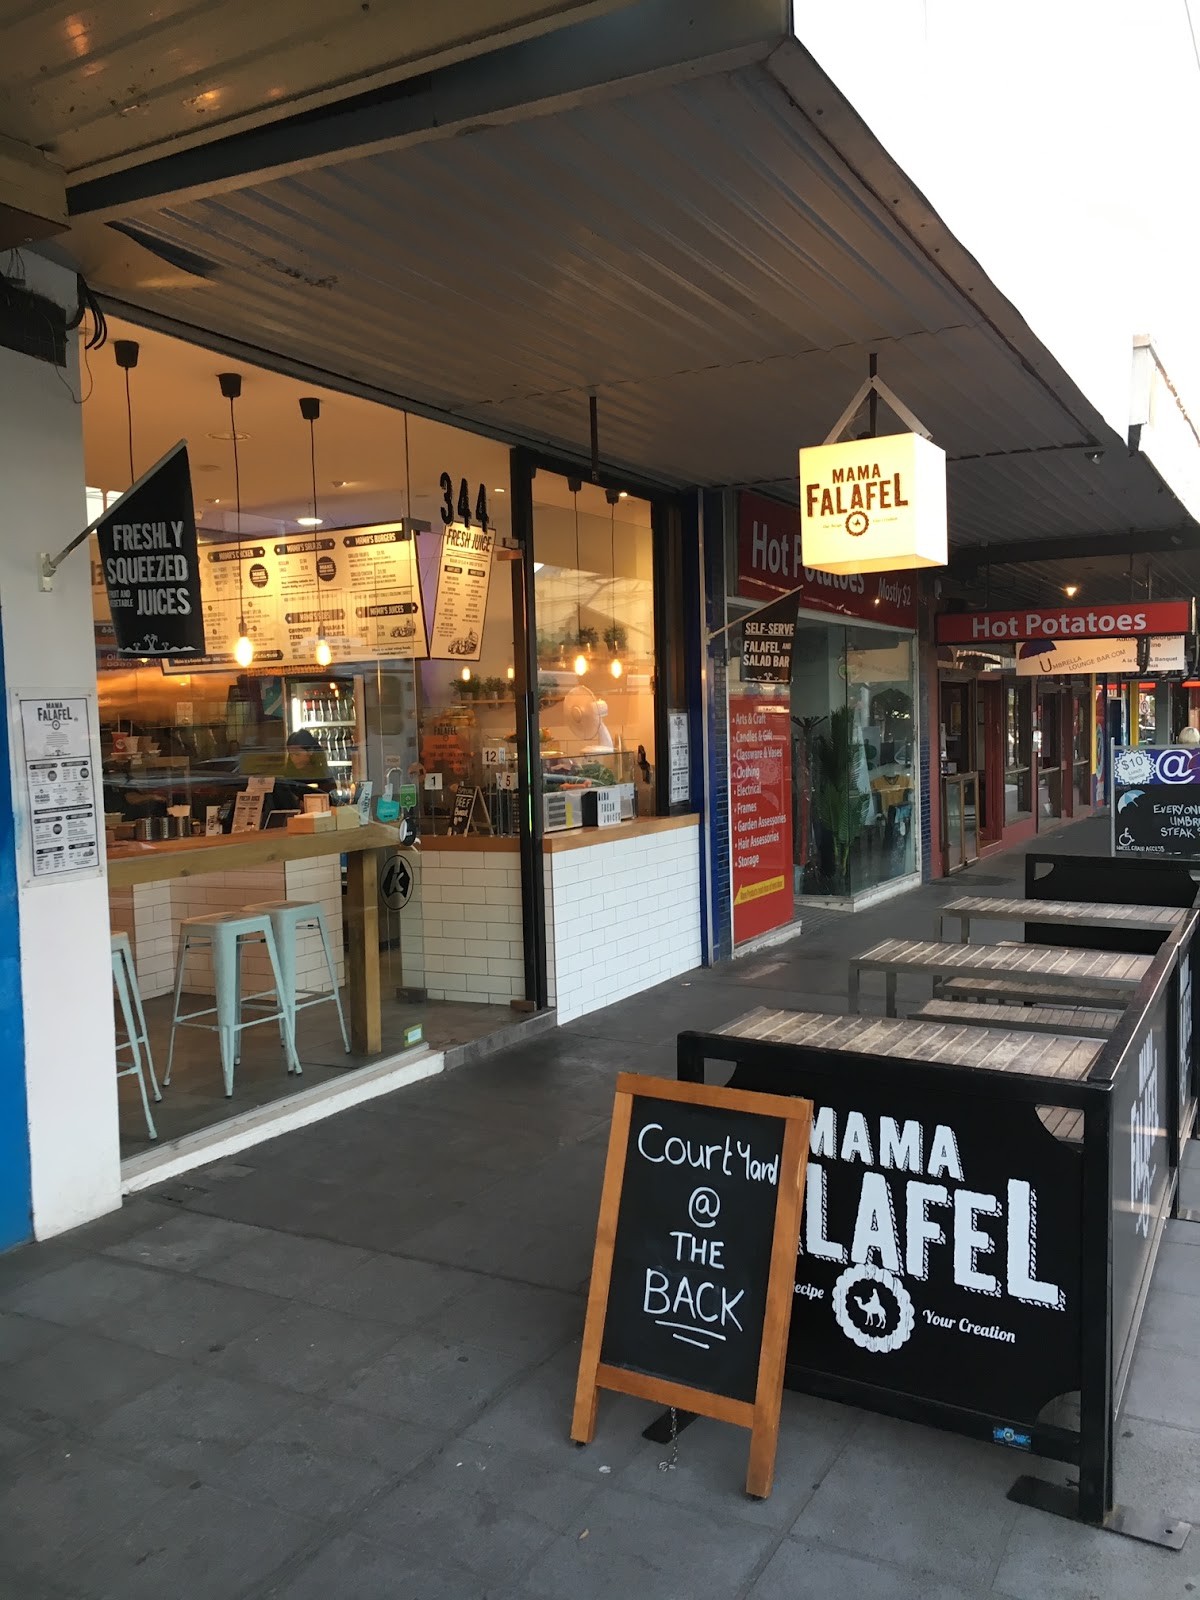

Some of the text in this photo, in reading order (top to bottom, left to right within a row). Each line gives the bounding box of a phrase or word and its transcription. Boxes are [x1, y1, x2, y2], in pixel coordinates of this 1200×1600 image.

[832, 463, 881, 484] MAMA
[440, 472, 489, 533] 344
[806, 473, 908, 517] FALAFEL
[113, 521, 184, 551] FRESHLY
[446, 529, 491, 552] FRESH JUICE
[752, 520, 789, 576] Hot
[106, 554, 189, 585] SQUEEZED
[878, 577, 911, 608] Mostly $2
[137, 588, 192, 616] JUICES
[745, 622, 794, 635] SELF-SERVE
[972, 612, 1147, 638] Hot Potatoes
[744, 641, 780, 653] FALAFEL
[743, 655, 789, 667] SALAD BAR
[1069, 660, 1095, 671] LOUNGE
[1096, 653, 1110, 663] BAR
[37, 706, 72, 721] FALAFEL
[735, 713, 747, 725] Arts
[753, 712, 766, 724] Craft
[735, 731, 757, 743] Candles
[485, 751, 496, 762] 12
[768, 746, 783, 758] Vases
[1121, 756, 1143, 770] $10
[736, 765, 760, 780] Clothing
[505, 775, 511, 787] 5
[737, 782, 761, 797] Electrical
[737, 802, 757, 815] Frames
[738, 818, 758, 832] Garden
[1160, 827, 1196, 839] STEAK
[738, 837, 750, 850] Hair
[738, 854, 760, 868] Storage
[809, 1106, 965, 1182] MAMA
[688, 1186, 721, 1228] @
[669, 1231, 725, 1269] THE
[643, 1268, 745, 1332] BACK
[793, 1281, 1016, 1343] ecipe Your Creation
